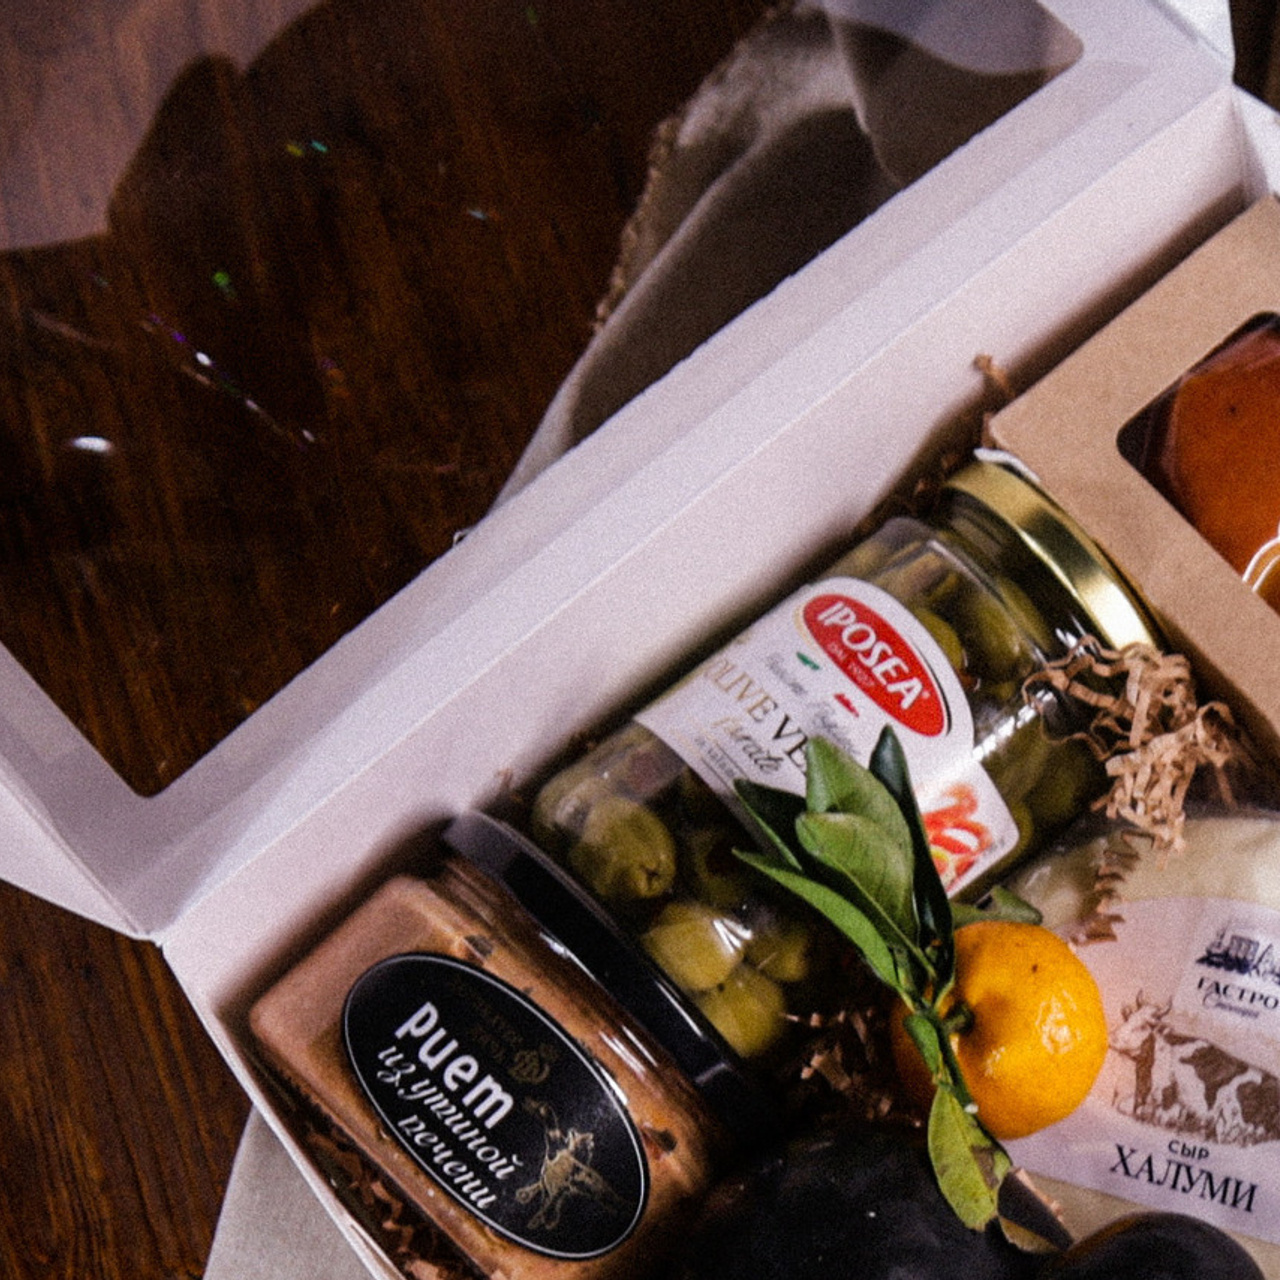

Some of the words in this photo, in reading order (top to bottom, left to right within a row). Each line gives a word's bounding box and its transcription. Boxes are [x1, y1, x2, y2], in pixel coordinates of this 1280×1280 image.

[817, 601, 924, 711] IPOSEA
[1197, 977, 1279, 1011] ГАСТРО
[377, 1046, 416, 1087] из
[398, 1078, 523, 1180] утиной
[398, 1114, 498, 1209] печени
[1110, 1144, 1258, 1213] ХАЛУМИ
